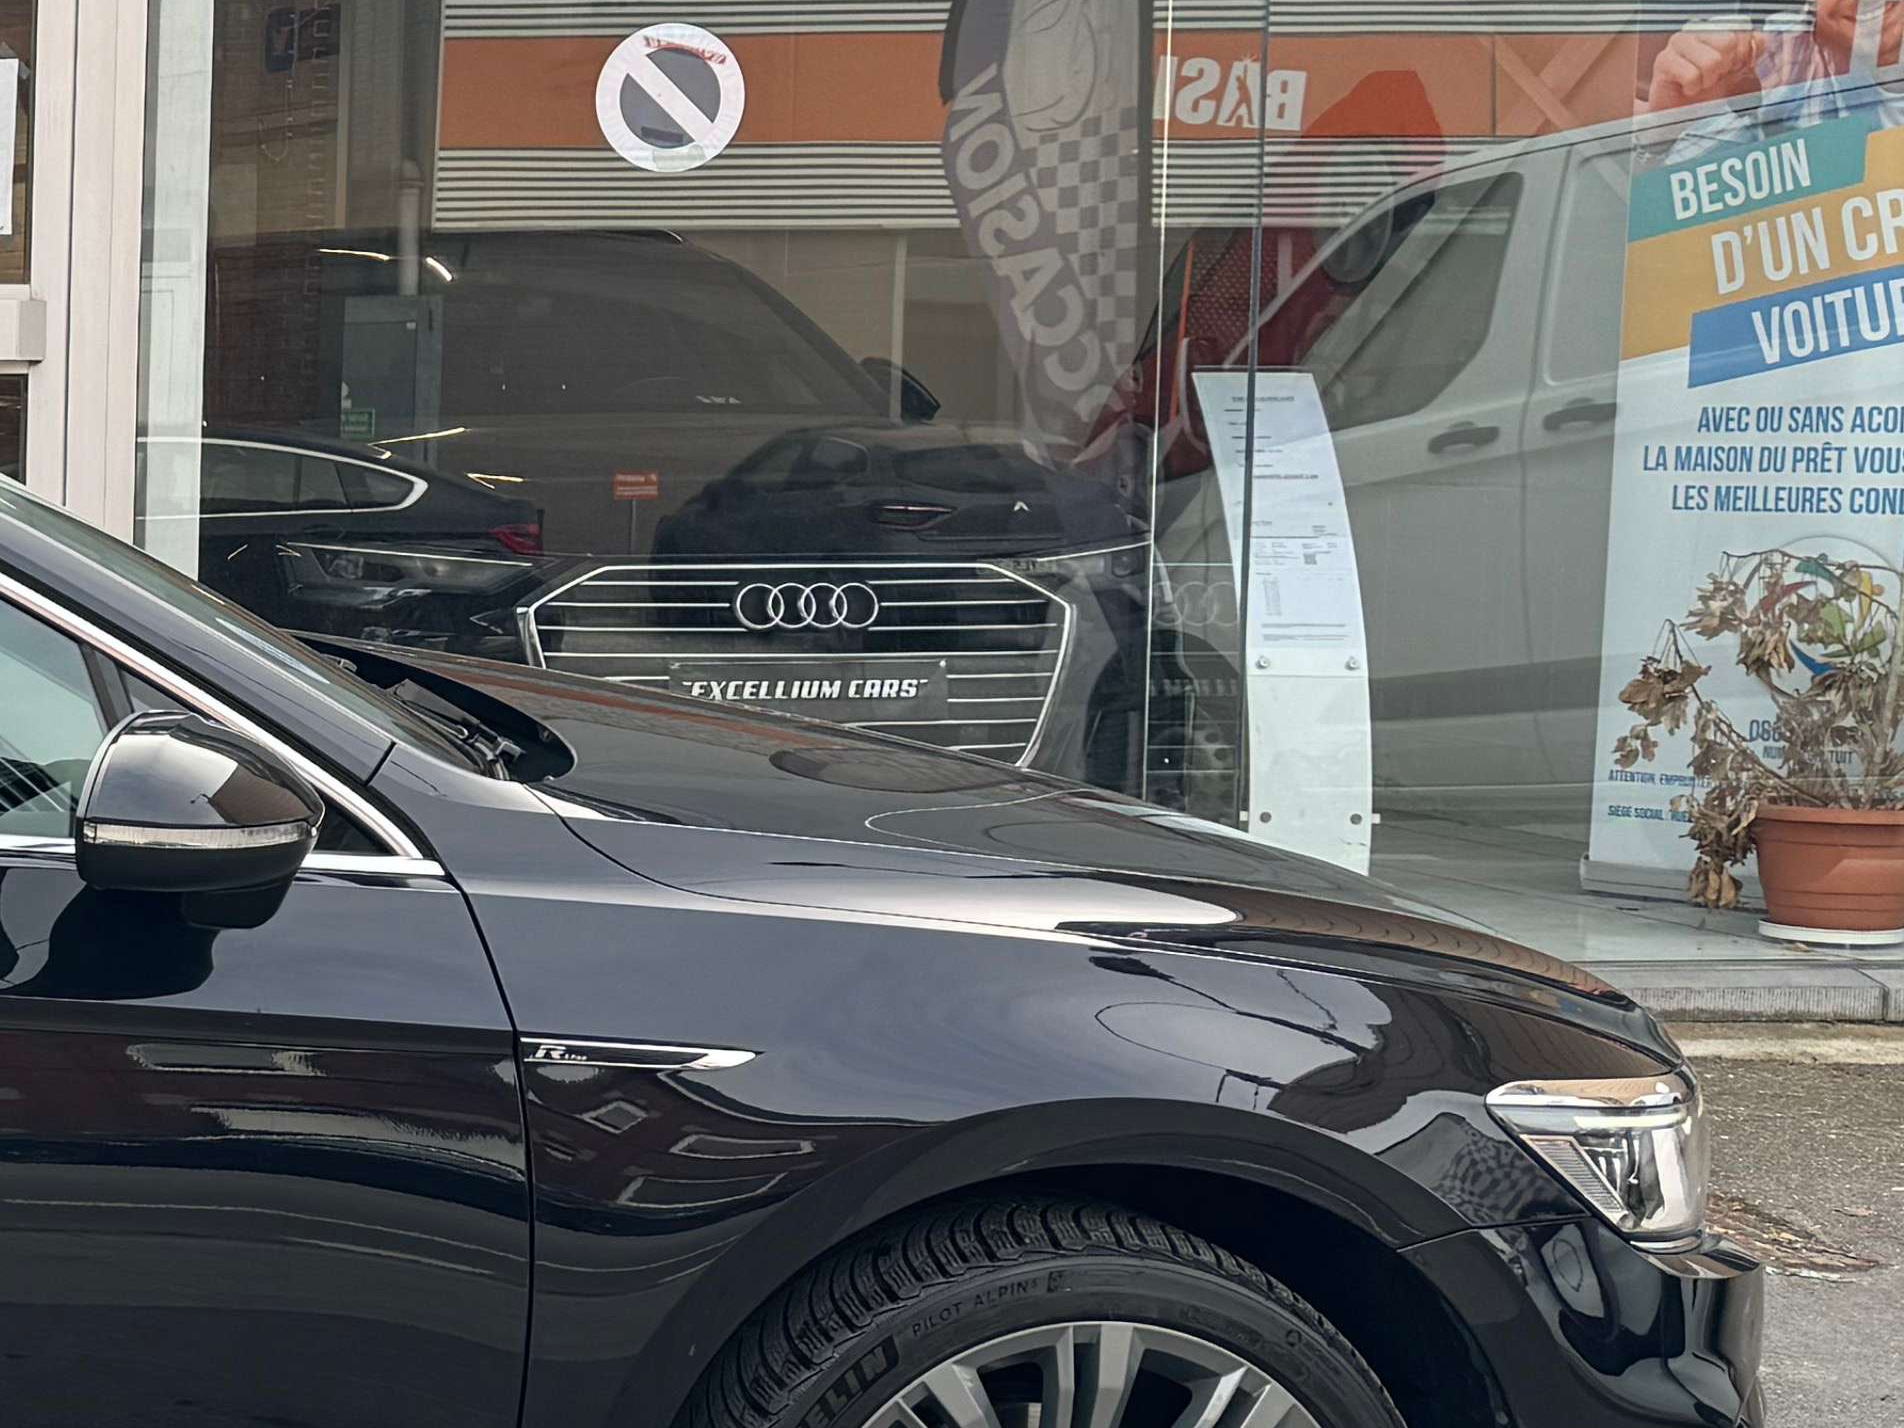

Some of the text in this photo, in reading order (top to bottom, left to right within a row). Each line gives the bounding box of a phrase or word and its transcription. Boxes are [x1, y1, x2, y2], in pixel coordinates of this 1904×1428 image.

[1669, 138, 1812, 222] BESOIN
[1752, 278, 1904, 366] VOITU
[1697, 406, 1904, 434] AVEC OU SANS ACO
[1642, 445, 1669, 471] LA
[1674, 445, 1754, 472] MAISON
[1758, 446, 1787, 473] DU
[1791, 442, 1847, 474] PRÊT
[1672, 484, 1709, 511] LES
[1714, 485, 1843, 514] MEILLEURES
[691, 679, 919, 700] EXCELLIUM CARS
[912, 1301, 963, 1337] PILOT
